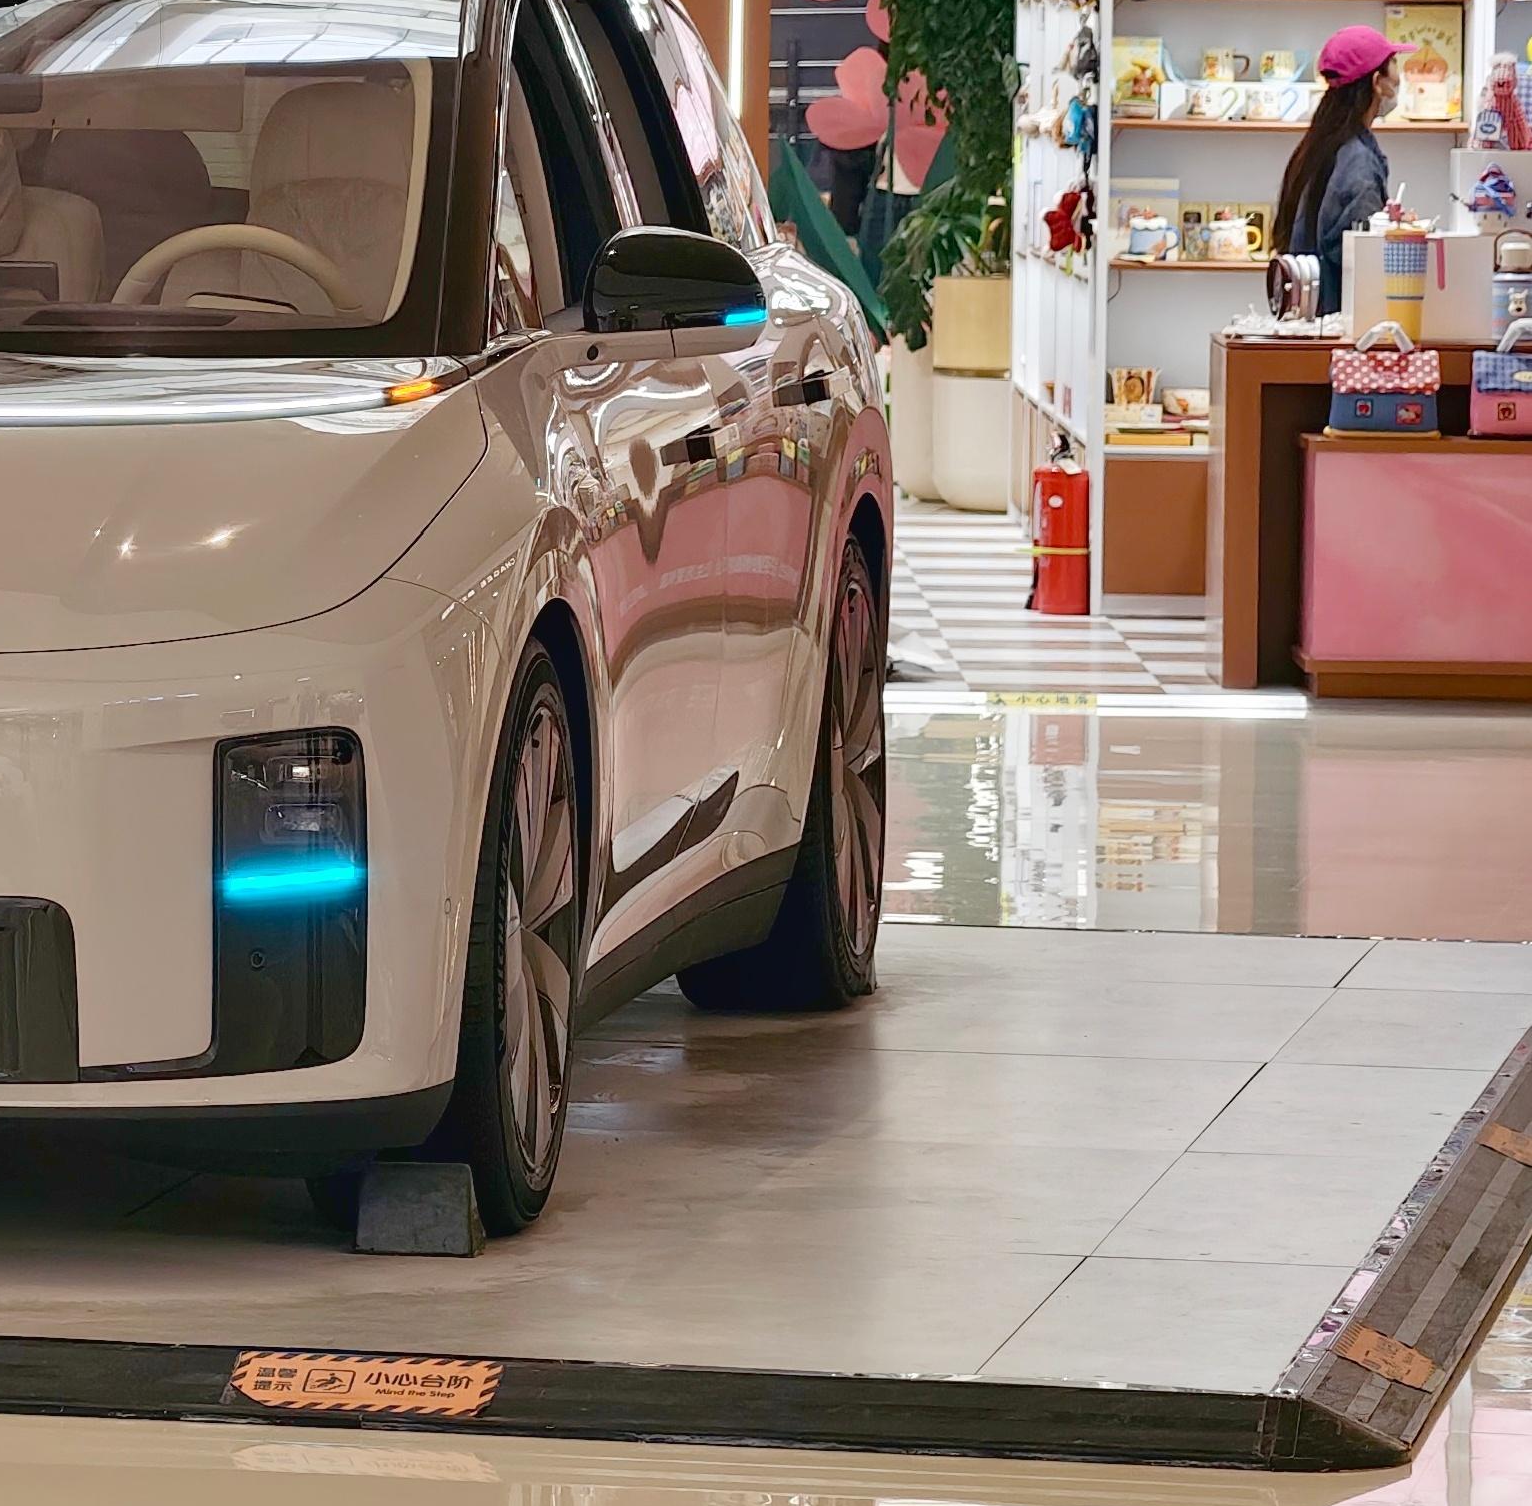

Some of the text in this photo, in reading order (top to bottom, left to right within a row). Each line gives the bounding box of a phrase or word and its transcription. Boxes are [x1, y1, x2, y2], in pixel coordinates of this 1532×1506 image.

[255, 1366, 299, 1379] 温馨
[252, 1379, 294, 1392] 提示
[363, 1370, 475, 1390] 小心台阶
[374, 1388, 457, 1399] Mind the Step
